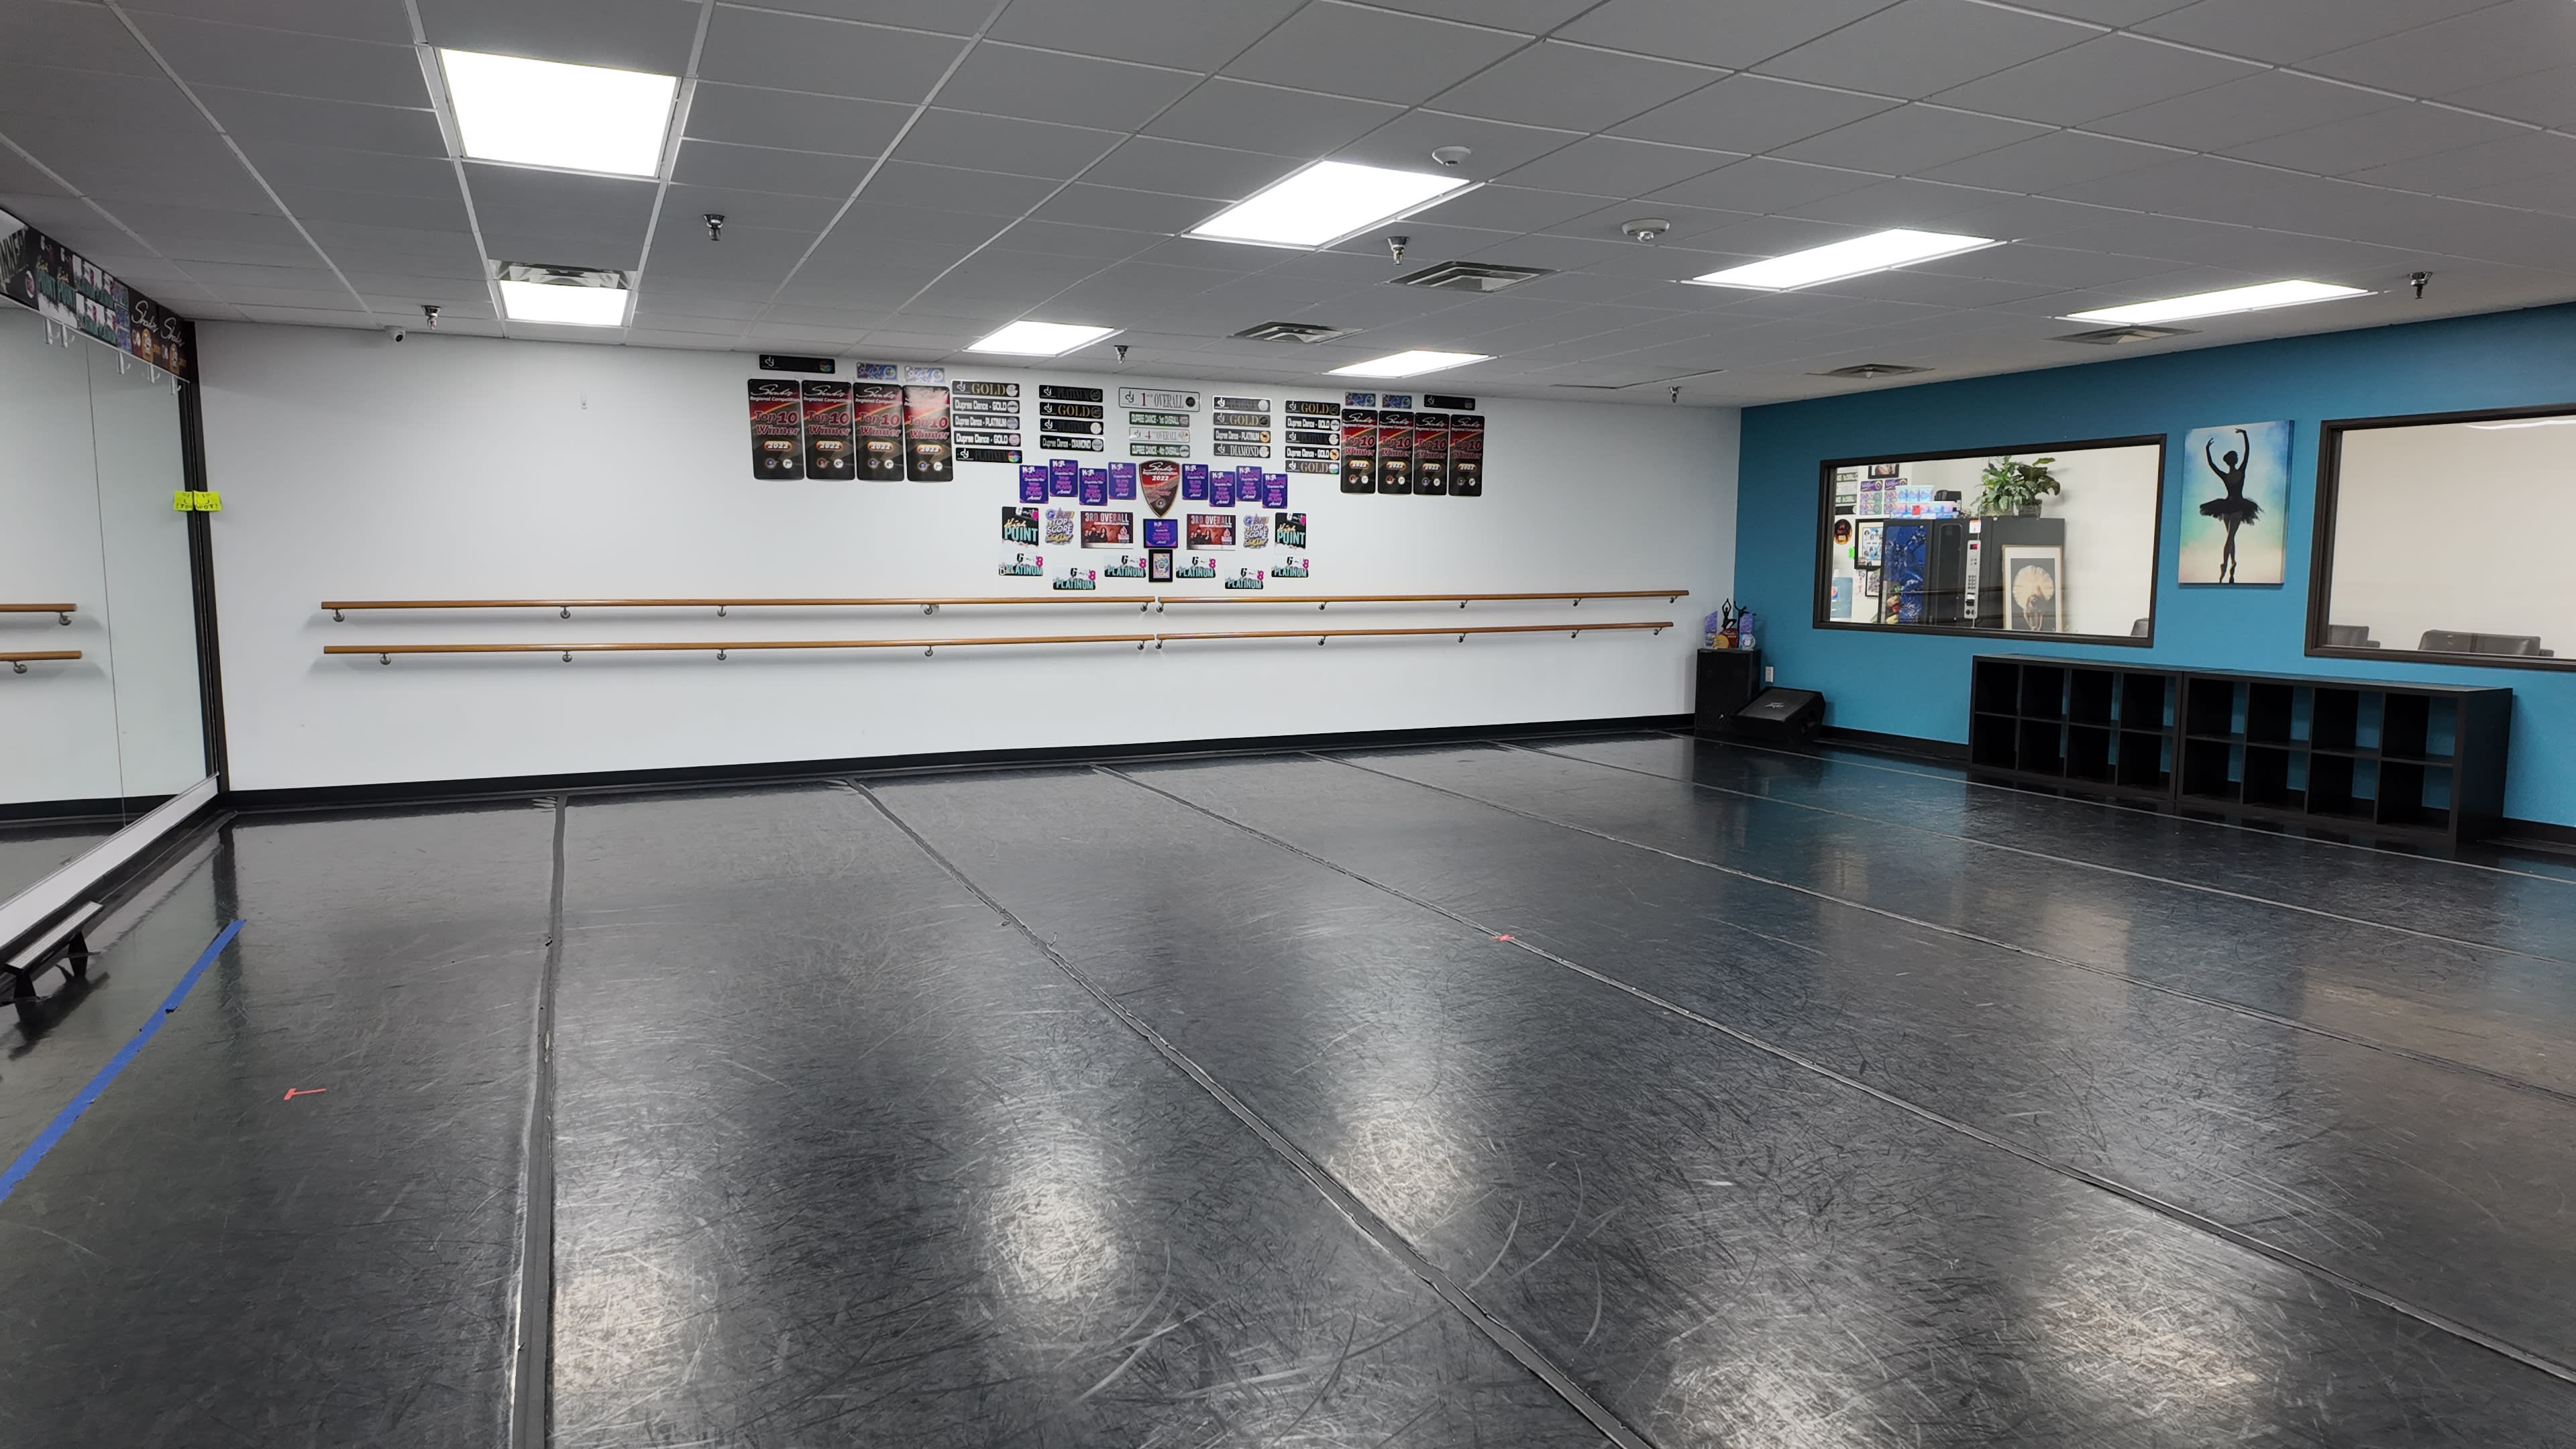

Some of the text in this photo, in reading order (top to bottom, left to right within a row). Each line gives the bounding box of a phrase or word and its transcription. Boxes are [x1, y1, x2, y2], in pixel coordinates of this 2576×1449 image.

[971, 383, 1006, 395] GOLD
[992, 401, 1007, 411] GOLD
[1154, 393, 1184, 409] OVERALL
[1058, 405, 1090, 417] GOLD
[1301, 402, 1329, 414] GOLD
[1230, 415, 1259, 425] GOLD
[756, 424, 800, 435] Winner
[808, 424, 851, 435] Winner
[860, 425, 901, 437] Winner
[909, 429, 949, 440] Winner
[994, 435, 1008, 444] GOLD
[1156, 431, 1178, 441] OVERALL
[1230, 445, 1259, 457] DIAMOND
[1344, 447, 1375, 456] Winner
[1382, 447, 1412, 458] Winner
[1300, 462, 1329, 473] GOLD
[1052, 518, 1069, 526] TOP
[1085, 513, 1098, 522] 3RD
[1100, 513, 1130, 523] OVERALL
[1191, 515, 1232, 525] 3RD OVERALL
[1047, 525, 1073, 535] SCORE
[1250, 523, 1264, 531] TOP
[1004, 527, 1038, 542] POINT
[1245, 529, 1268, 539] SCORE
[1277, 531, 1305, 545] POINT
[1107, 566, 1144, 577] PLATINUM
[1179, 567, 1214, 578] PLATINUM
[1275, 567, 1307, 578] PLATINUM
[1056, 578, 1094, 590] PLATINUM
[1228, 578, 1262, 589] PLATINUM
